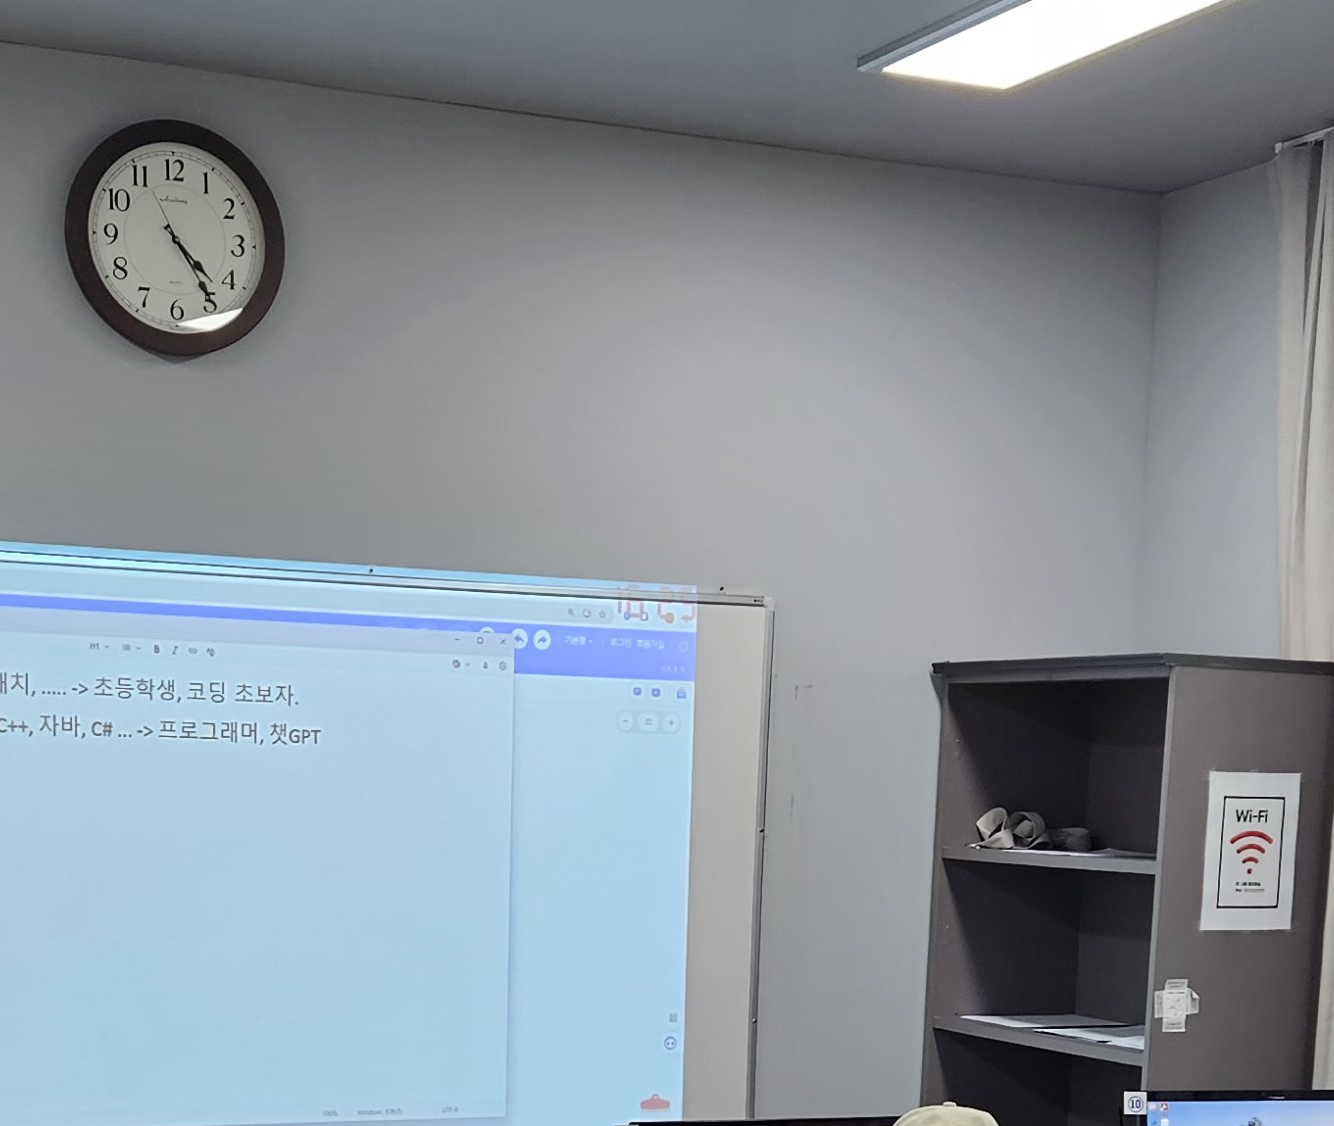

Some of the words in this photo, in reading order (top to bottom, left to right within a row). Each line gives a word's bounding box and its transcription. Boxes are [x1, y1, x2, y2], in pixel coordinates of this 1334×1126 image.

[133, 165, 147, 187] 11
[165, 159, 184, 181] 12
[203, 172, 208, 194] 1
[109, 188, 130, 212] 10
[224, 198, 234, 219] 2
[104, 223, 118, 244] 9
[231, 235, 244, 257] 3
[113, 257, 127, 279] 8
[222, 270, 235, 290] 4
[138, 287, 150, 308] 7
[202, 290, 217, 313] 5
[170, 300, 184, 320] 6
[72, 684, 88, 694] ->
[94, 677, 181, 703] 초등학생,
[187, 682, 224, 703] 코딩
[235, 684, 298, 706] 초보자.
[40, 715, 85, 739] 자바,
[92, 722, 113, 736] C#
[137, 726, 153, 736] ->
[158, 721, 263, 745] 프로그래머,
[270, 724, 321, 745] 챗GPT
[1236, 810, 1268, 822] Wi-Fi
